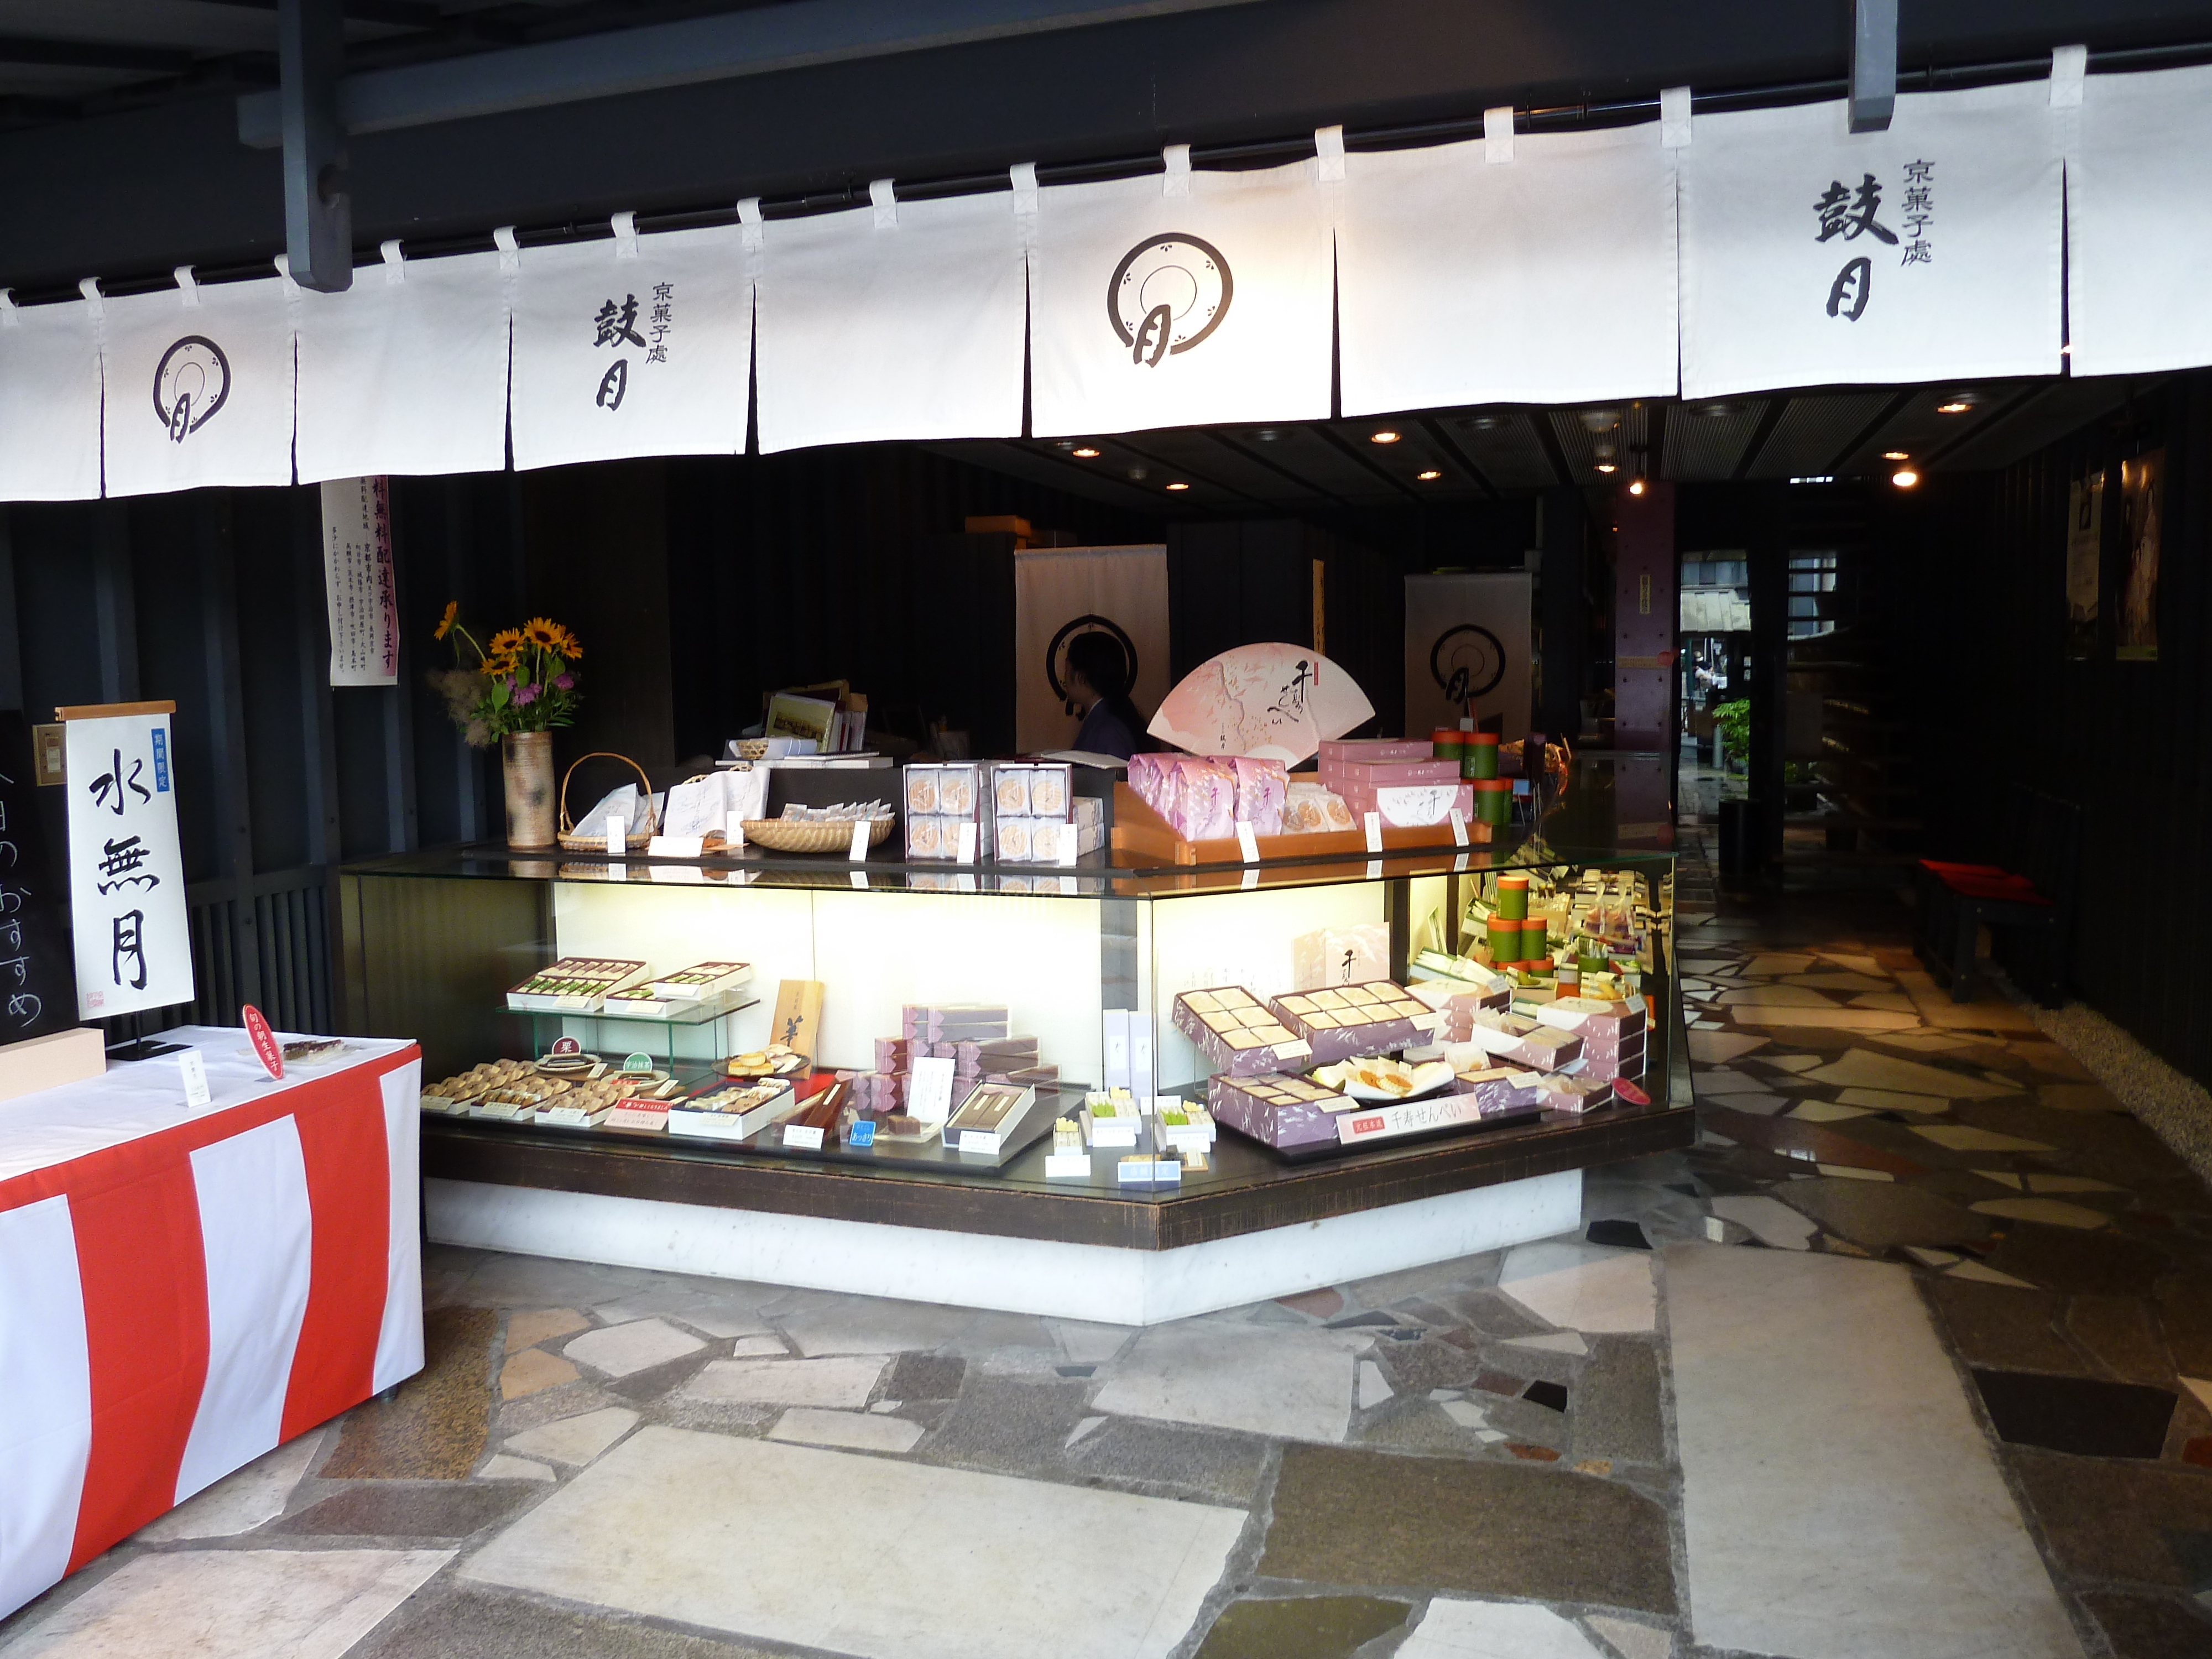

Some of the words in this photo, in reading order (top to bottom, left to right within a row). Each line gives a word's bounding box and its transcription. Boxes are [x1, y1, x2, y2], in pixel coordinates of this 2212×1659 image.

[1813, 173, 1900, 322] 鼓月
[1901, 158, 1936, 267] 京菓子處
[593, 294, 647, 411] 鼓月
[645, 282, 674, 365] 京菓子處
[88, 748, 160, 991] 水無月
[561, 1041, 573, 1053] 栗
[1391, 1103, 1463, 1129] 千寿せんべい
